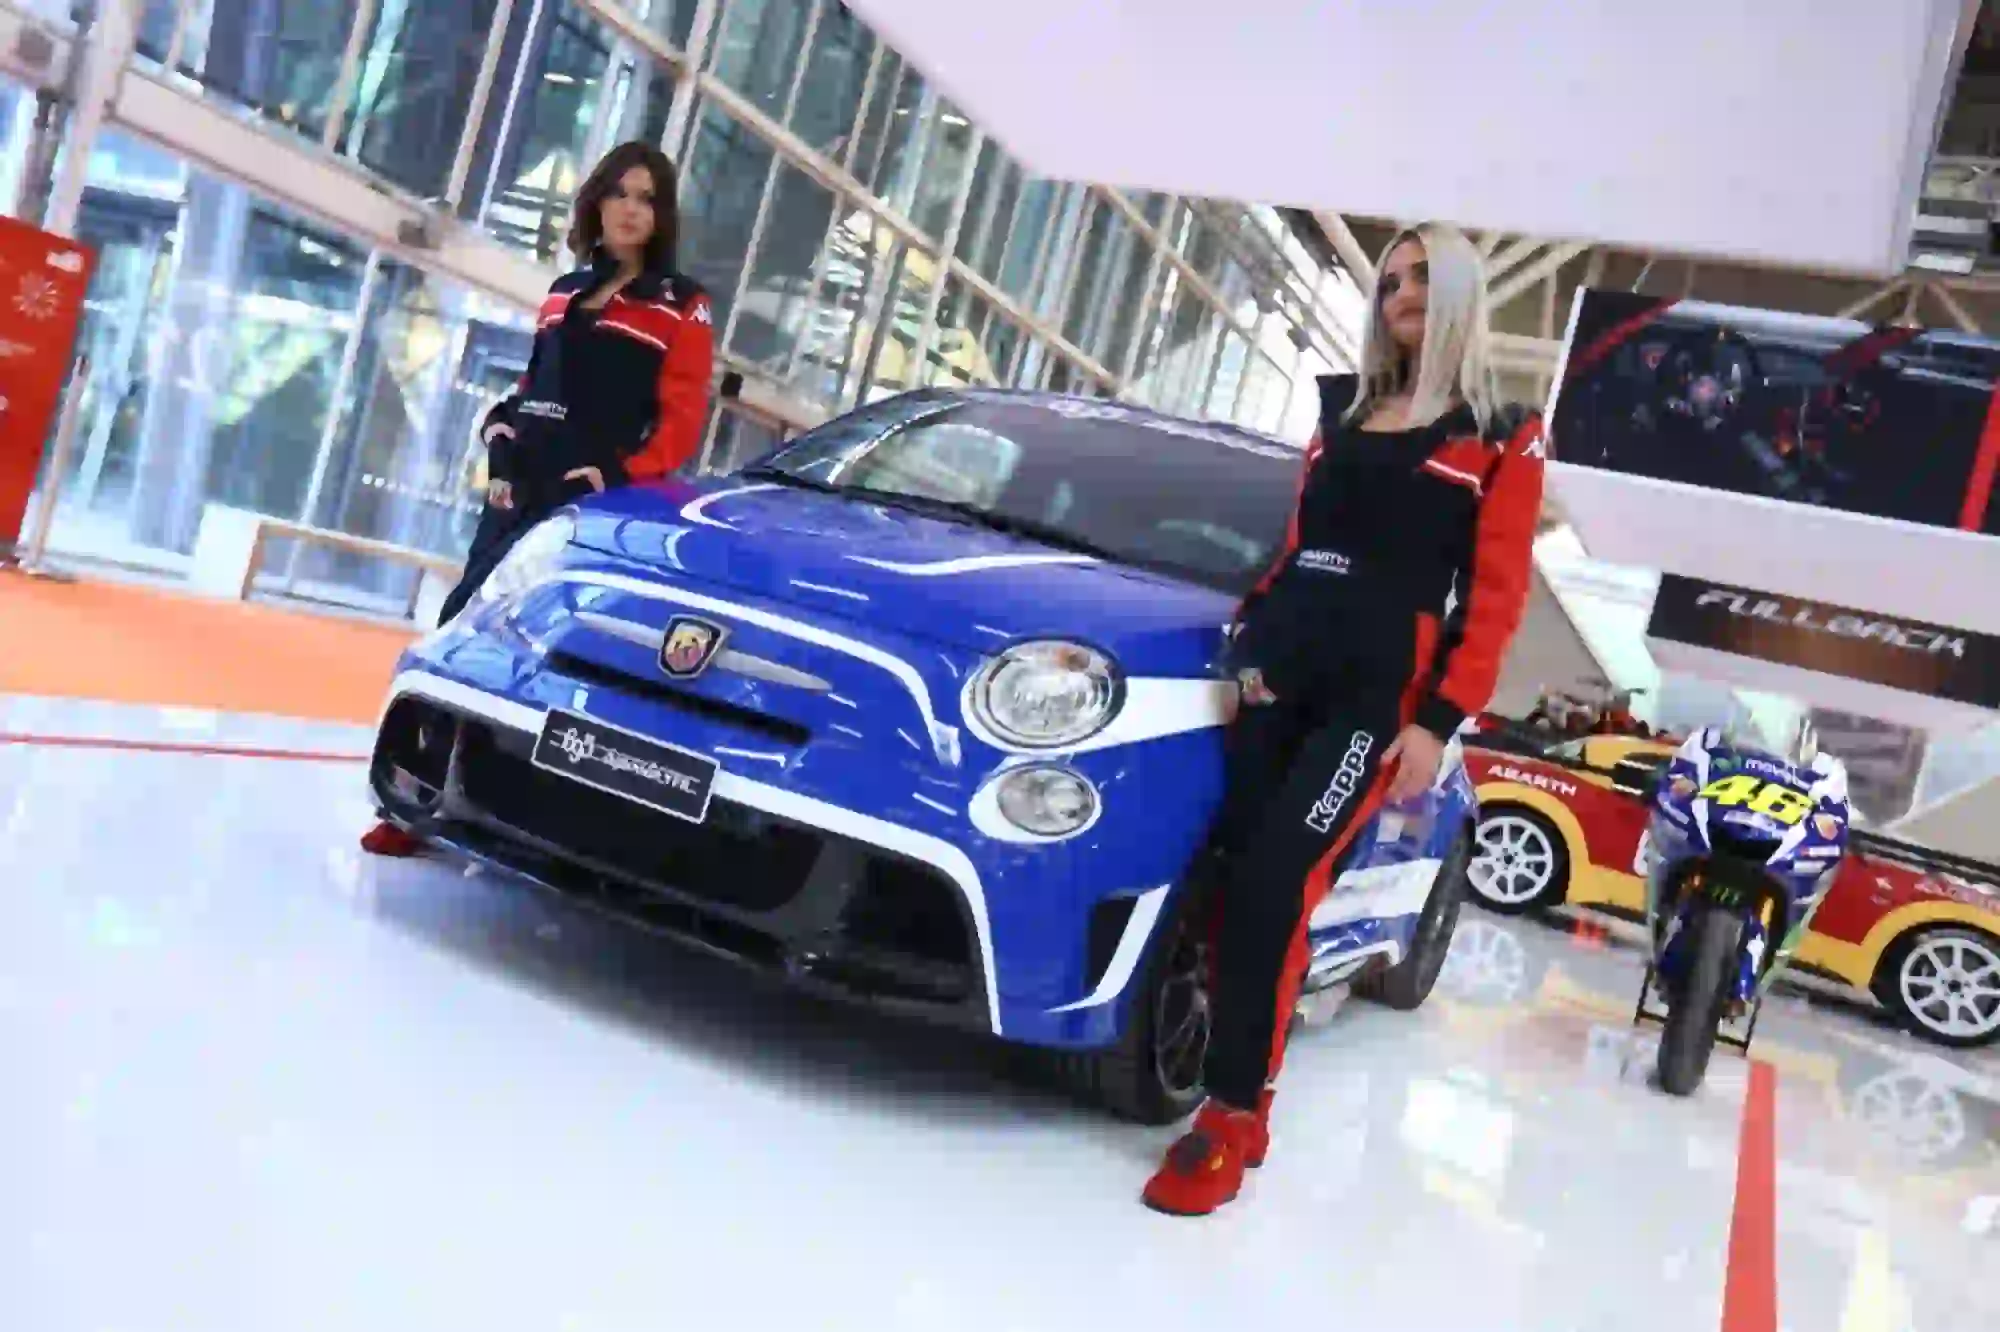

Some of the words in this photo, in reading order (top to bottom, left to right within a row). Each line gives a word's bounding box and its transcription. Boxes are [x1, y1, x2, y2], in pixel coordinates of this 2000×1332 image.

[1304, 730, 1374, 834] Kappa
[1486, 763, 1578, 797] ABARTH
[1697, 774, 1814, 826] 46
